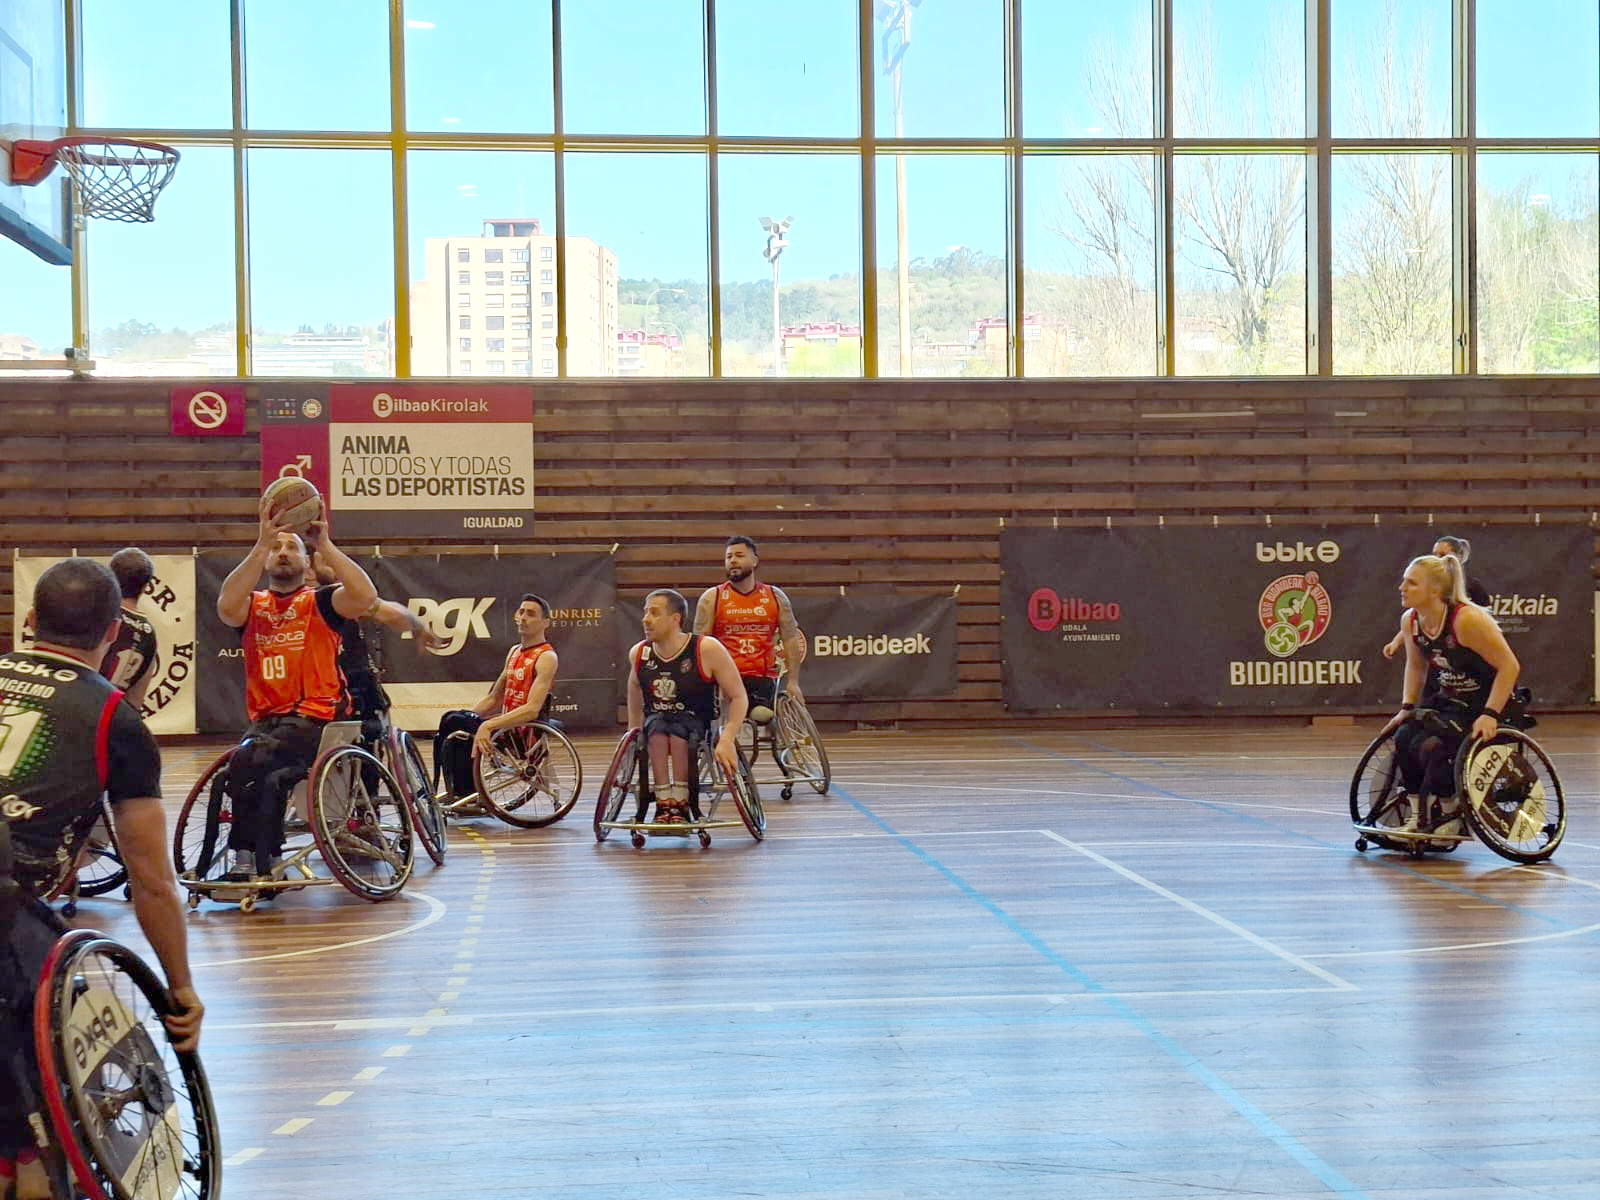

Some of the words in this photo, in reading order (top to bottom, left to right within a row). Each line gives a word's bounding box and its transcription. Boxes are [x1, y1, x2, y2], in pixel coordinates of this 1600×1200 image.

[374, 395, 488, 416] BilbaoKirolak
[341, 436, 410, 454] ANIMA
[342, 456, 355, 475] A
[359, 456, 426, 475] TODOS
[429, 456, 443, 475] Y
[447, 456, 512, 475] TODAS
[342, 477, 381, 496] LAS
[386, 477, 525, 496] DEPORTISTAS
[463, 517, 523, 528] IGUALDAD
[1256, 541, 1316, 562] bbk
[549, 608, 602, 619] UNRISE
[1031, 592, 1120, 625] Bilbao
[1490, 594, 1559, 616] izkaia
[551, 619, 600, 628] EDICAL
[740, 639, 755, 654] 25
[814, 633, 931, 656] Bidaideak
[263, 655, 286, 680] 09
[1230, 660, 1362, 685] BIDAIDEAK
[653, 678, 677, 698] 32
[555, 703, 578, 712] sport
